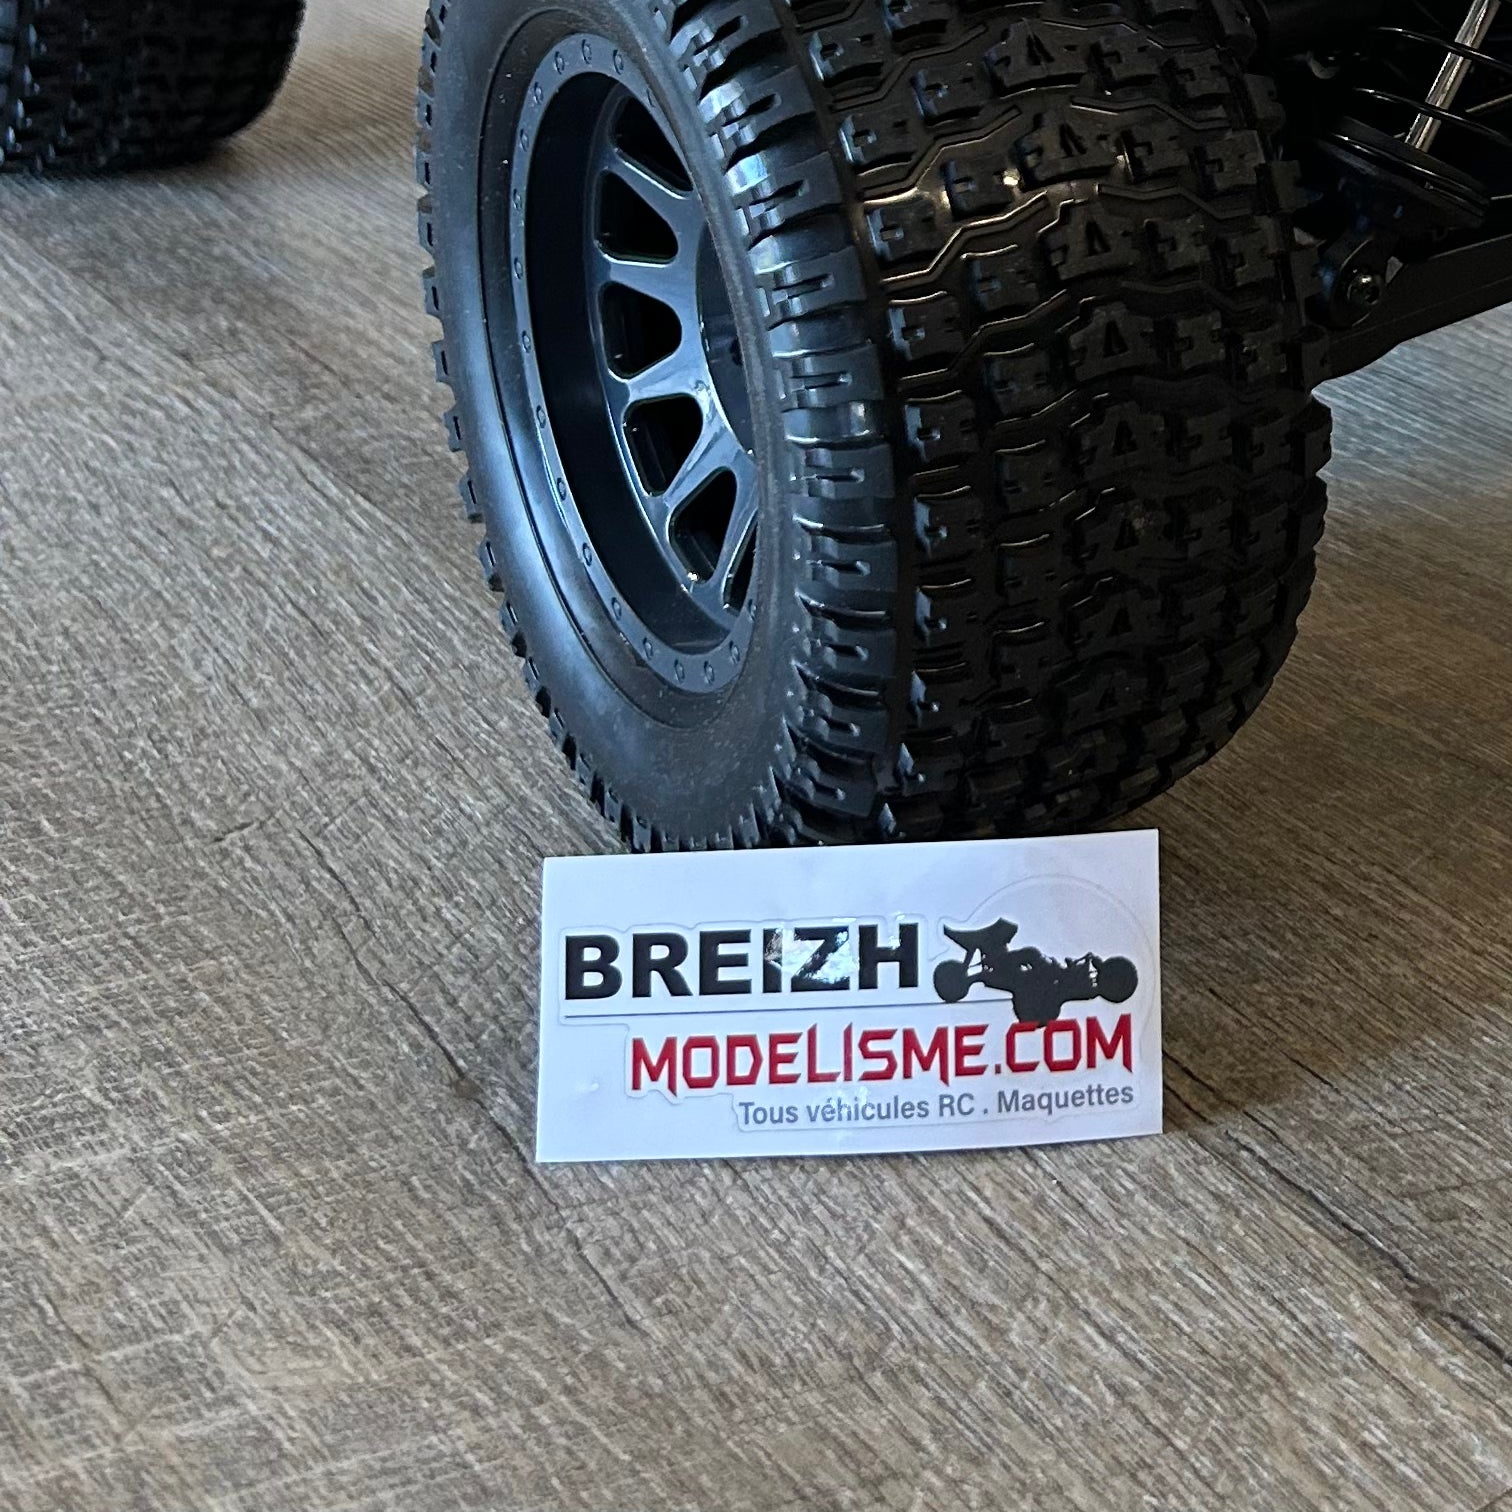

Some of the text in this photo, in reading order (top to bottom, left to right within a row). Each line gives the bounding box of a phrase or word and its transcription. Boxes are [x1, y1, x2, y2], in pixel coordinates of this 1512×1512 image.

[564, 921, 920, 1002] BREIZH
[630, 1014, 1134, 1098] MODELISME.COM
[738, 1100, 799, 1126] Tous
[805, 1092, 930, 1124] véhicules
[937, 1091, 976, 1118] RC
[997, 1084, 1135, 1116] Maquettes
